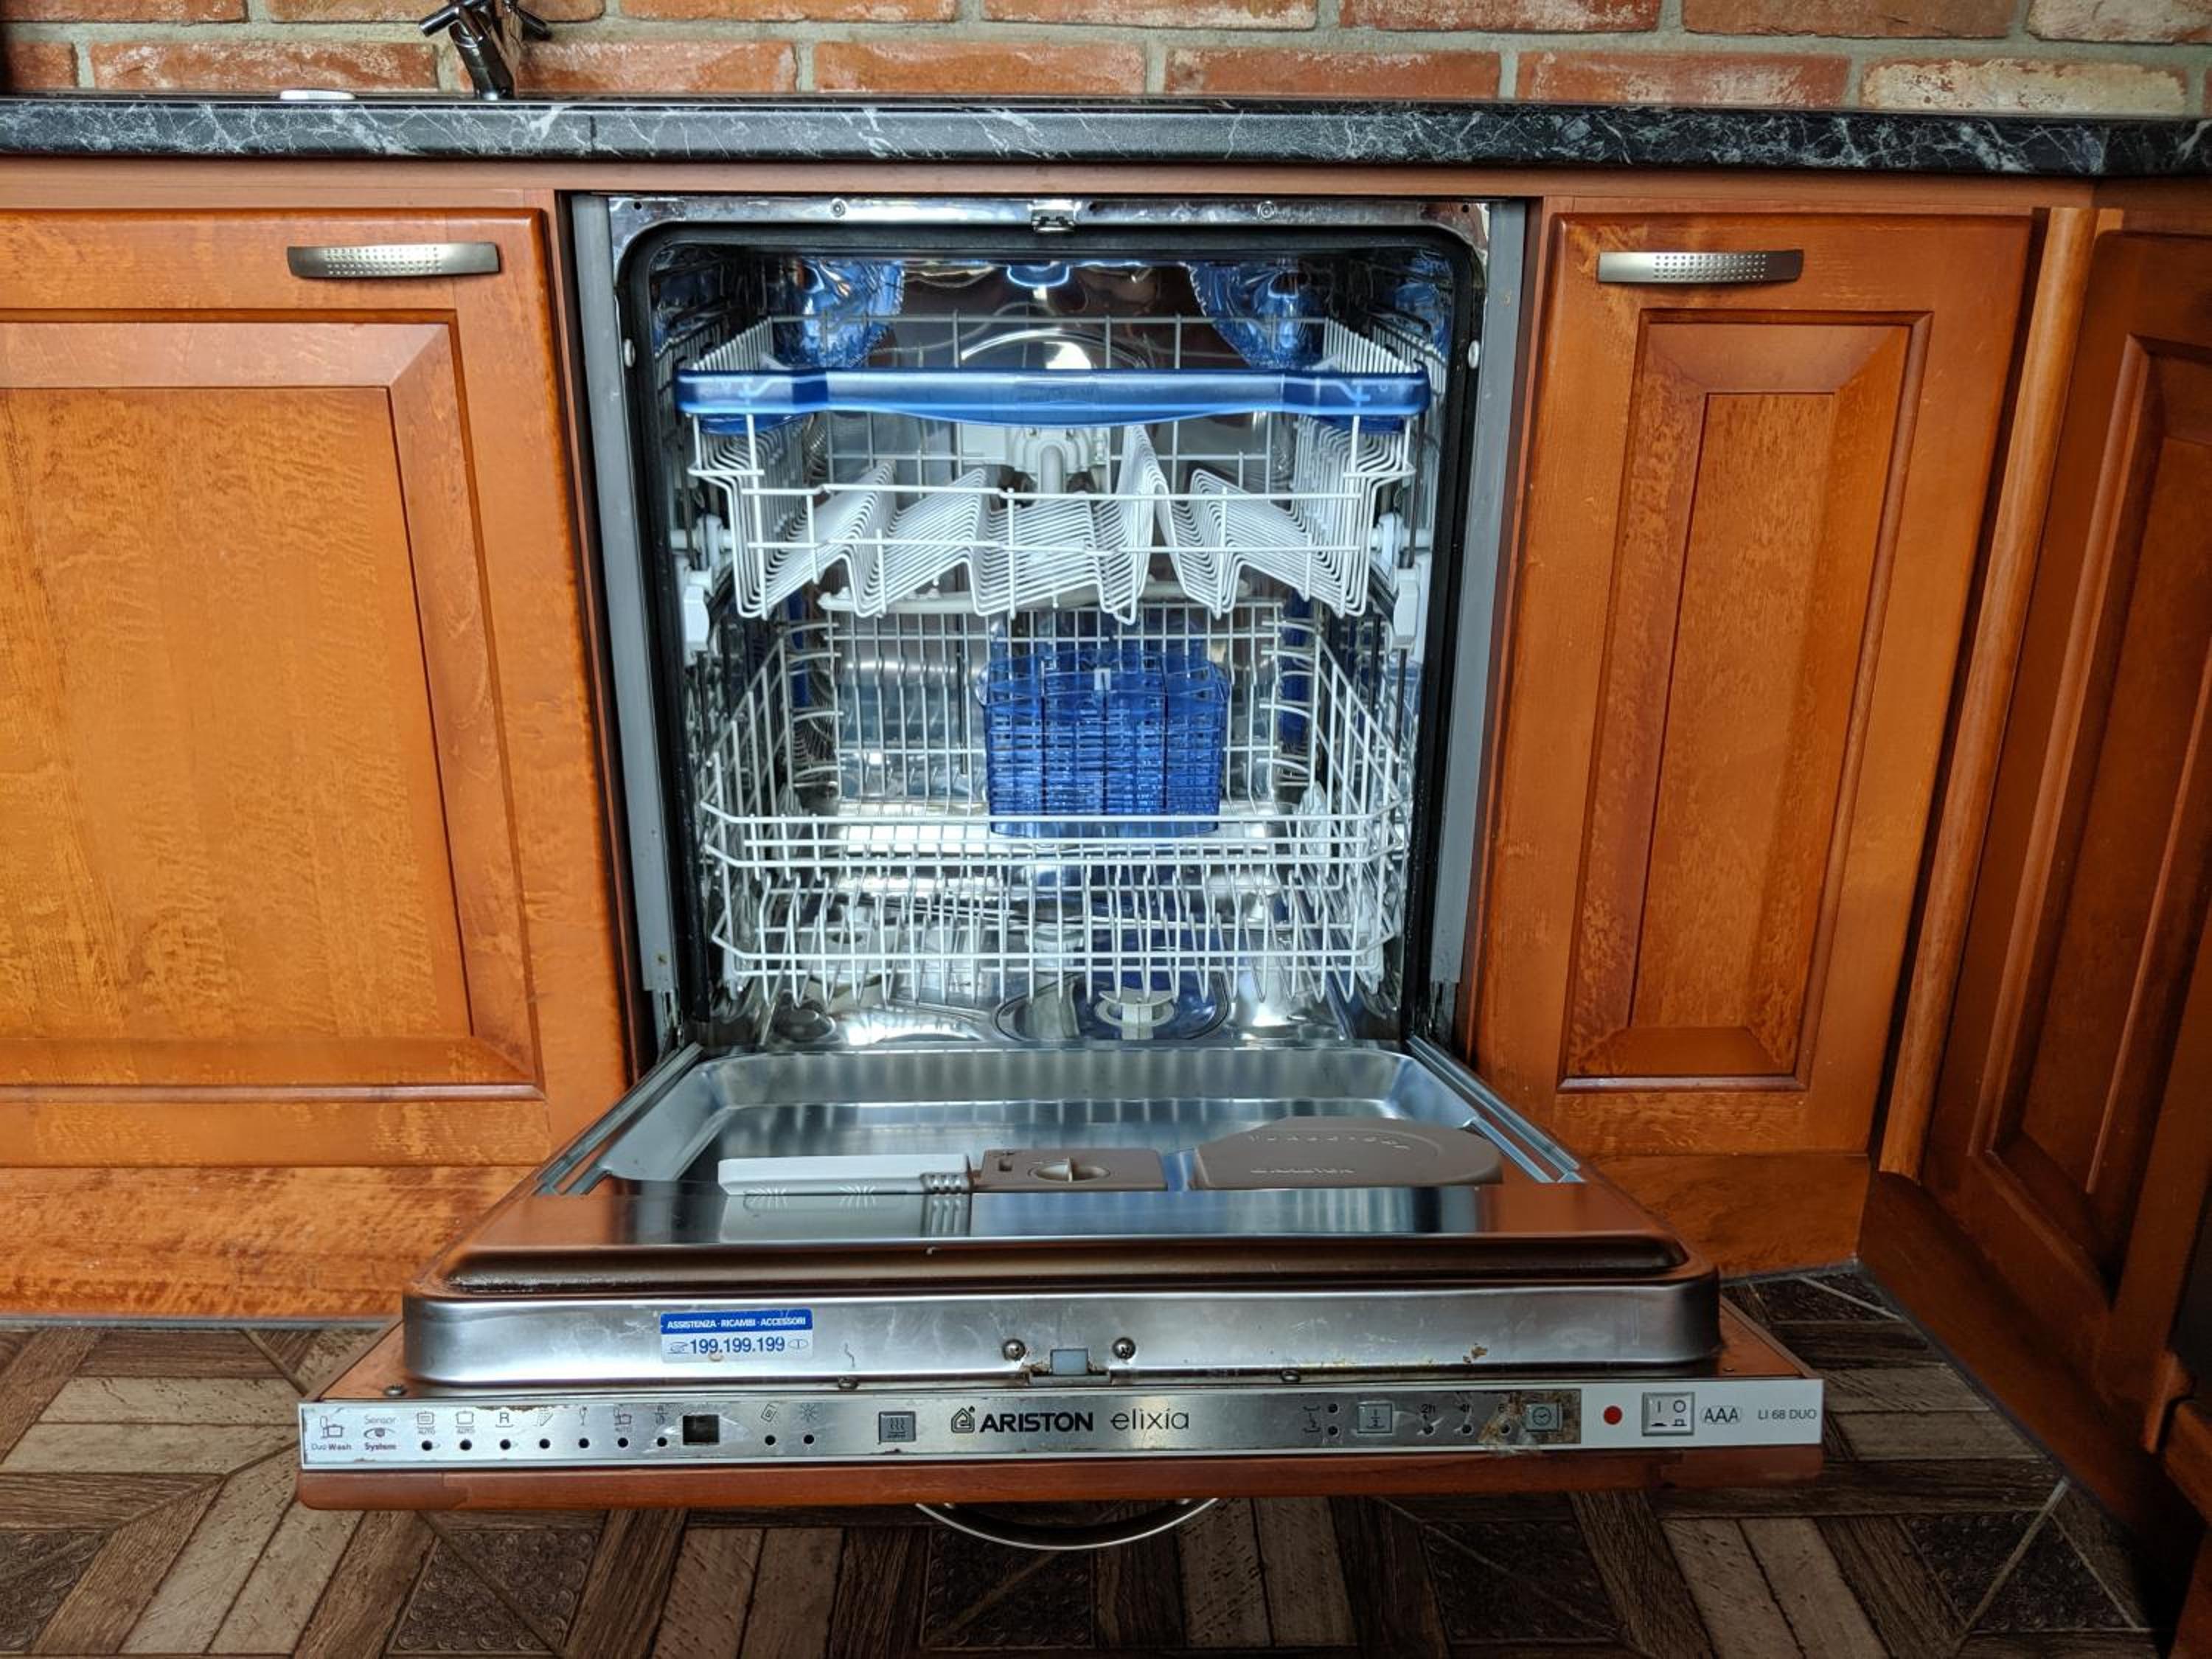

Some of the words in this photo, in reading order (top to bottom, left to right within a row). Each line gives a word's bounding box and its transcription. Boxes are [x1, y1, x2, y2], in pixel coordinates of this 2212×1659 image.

[667, 1319, 717, 1329] ASSISTENZA
[720, 1318, 756, 1327] RICAMBI
[760, 1316, 806, 1326] ACCESSORI
[690, 1336, 785, 1354] 199.199.199
[364, 1415, 397, 1425] Sensor
[1704, 1408, 1739, 1422] AAA
[1758, 1409, 1769, 1420] LI
[1771, 1409, 1786, 1420] 68
[1789, 1408, 1818, 1420] DUO
[980, 1412, 1093, 1433] ARISTON
[329, 1442, 352, 1450] Wash
[364, 1442, 397, 1451] System
